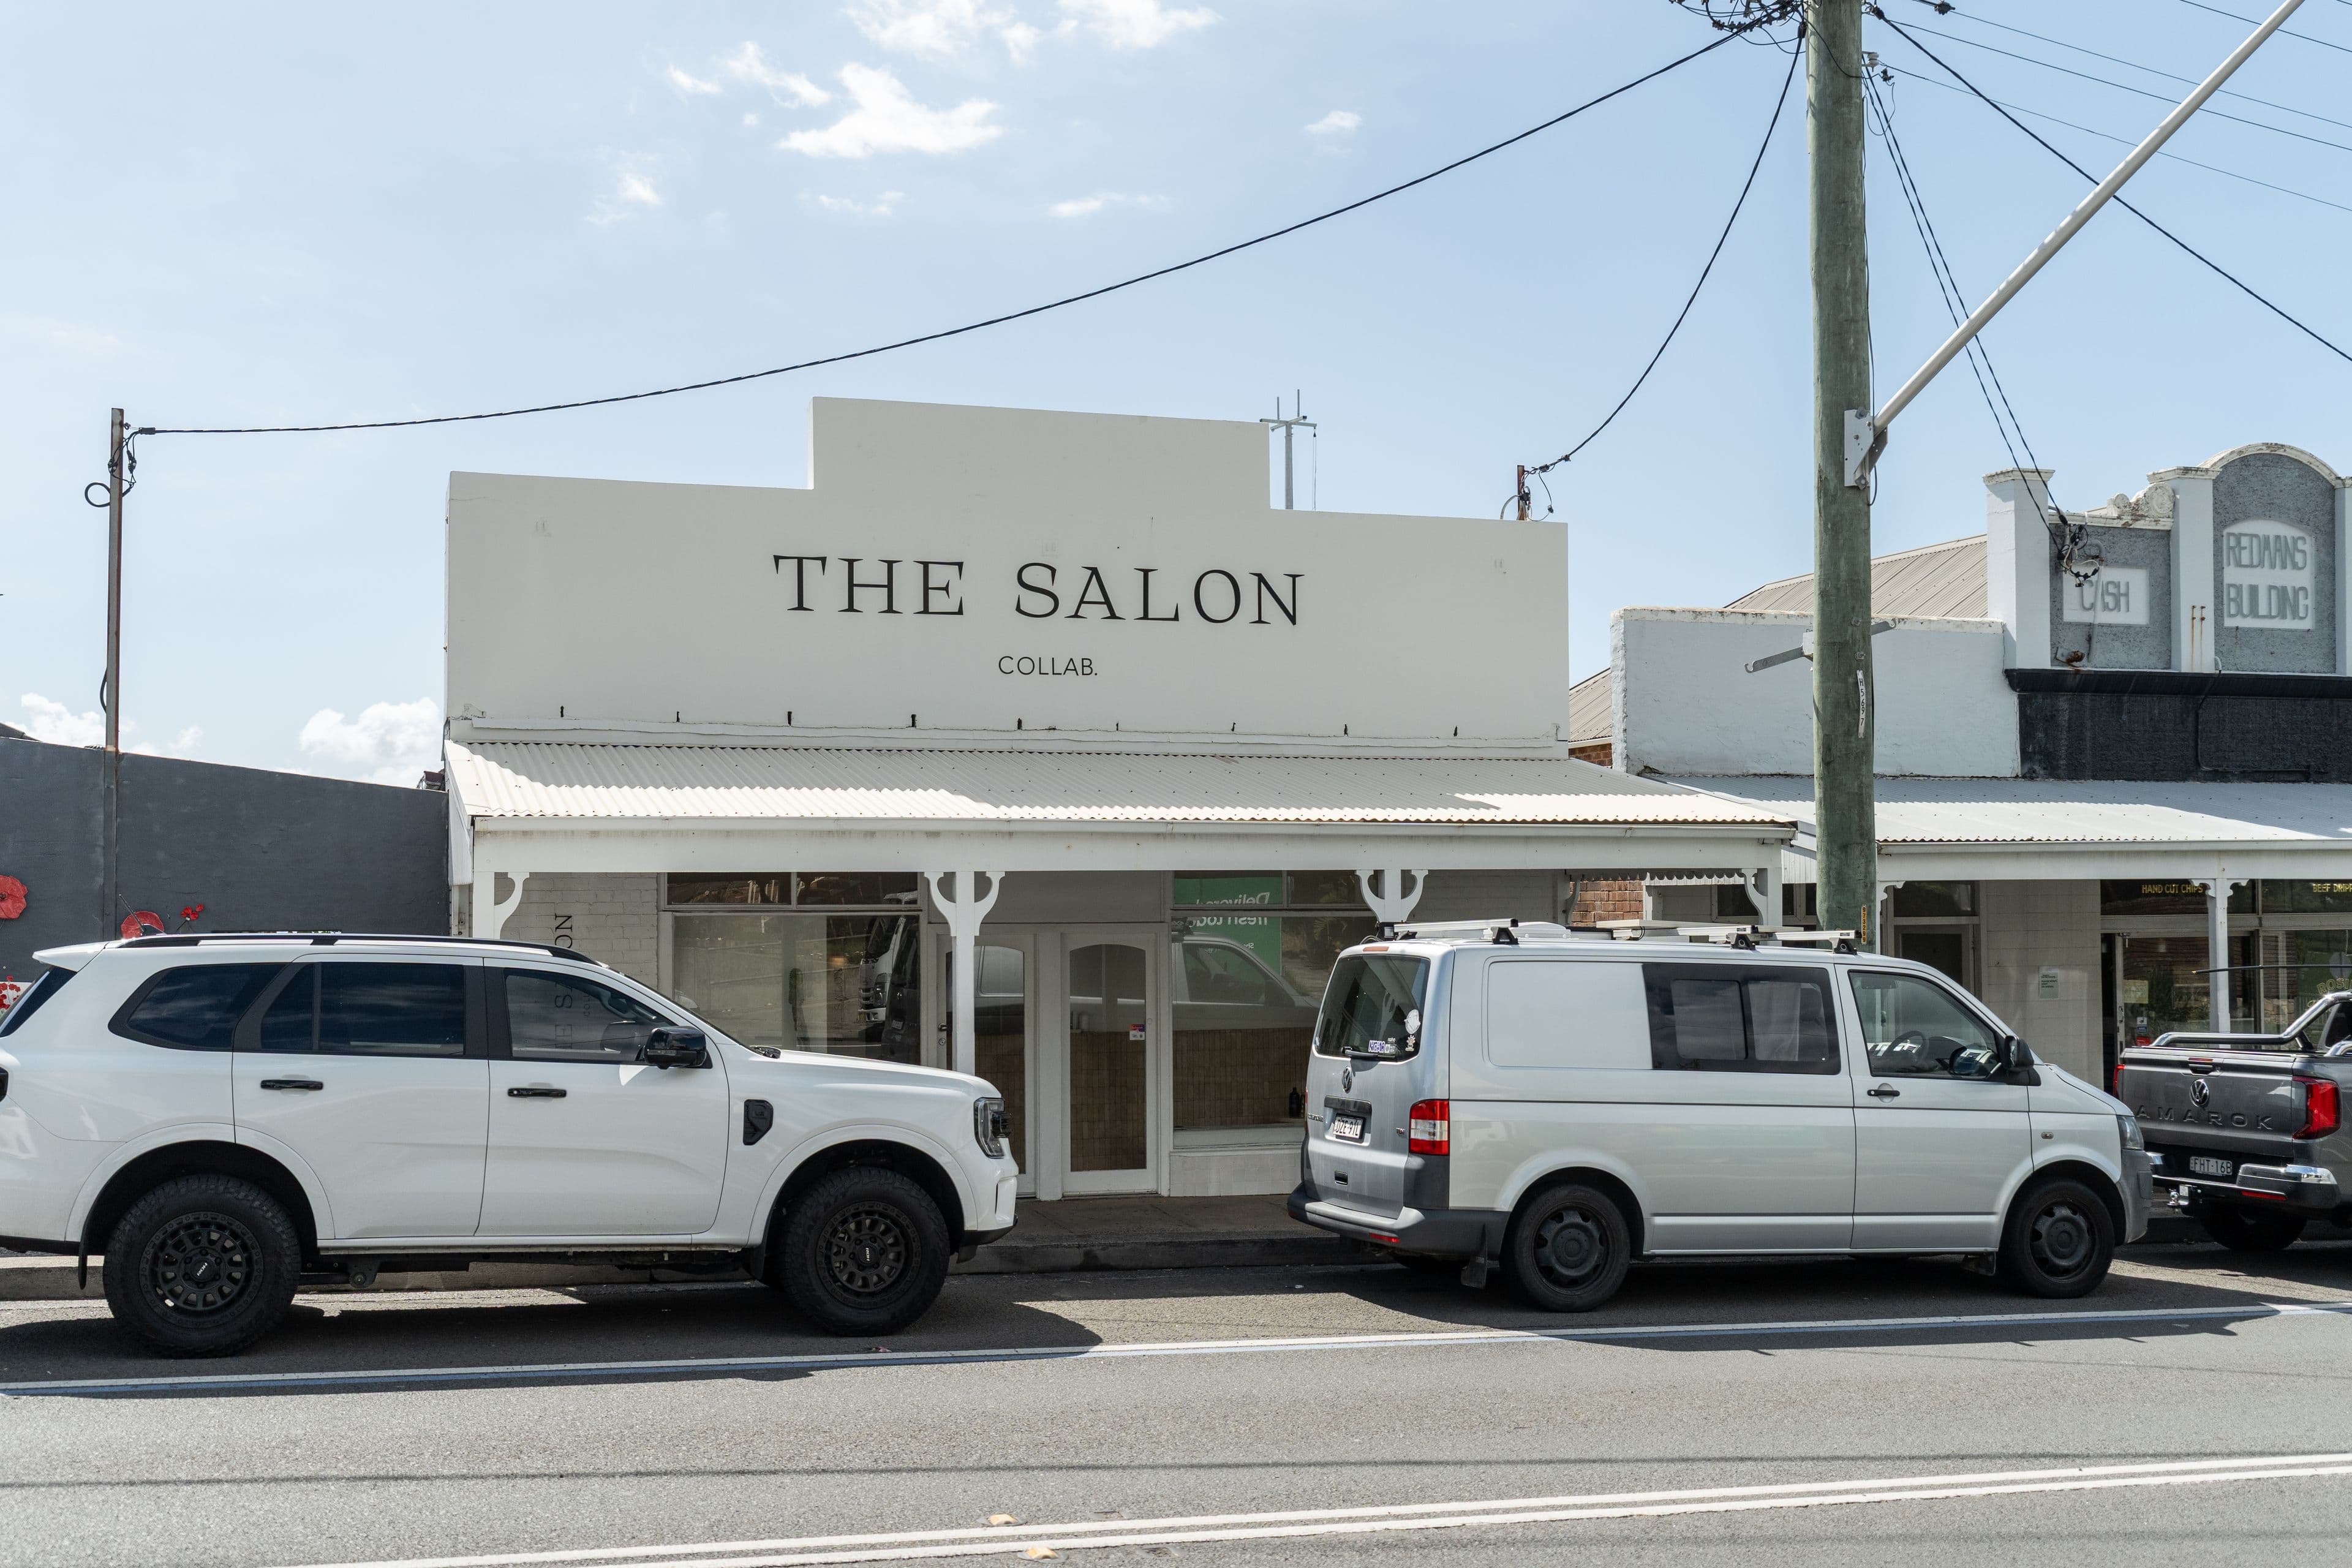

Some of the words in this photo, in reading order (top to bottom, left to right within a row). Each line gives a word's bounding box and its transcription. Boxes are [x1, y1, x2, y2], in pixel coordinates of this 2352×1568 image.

[773, 554, 964, 616] THE
[1014, 562, 1305, 625] SALON
[2227, 583, 2309, 619] BUILDING
[998, 655, 1098, 677] COLLAB.
[2142, 884, 2163, 894] HAND
[2165, 884, 2179, 894] CUT
[2180, 884, 2204, 894] CHIPS
[2312, 883, 2331, 892] BEEF
[2136, 1104, 2273, 1131] AMAROK
